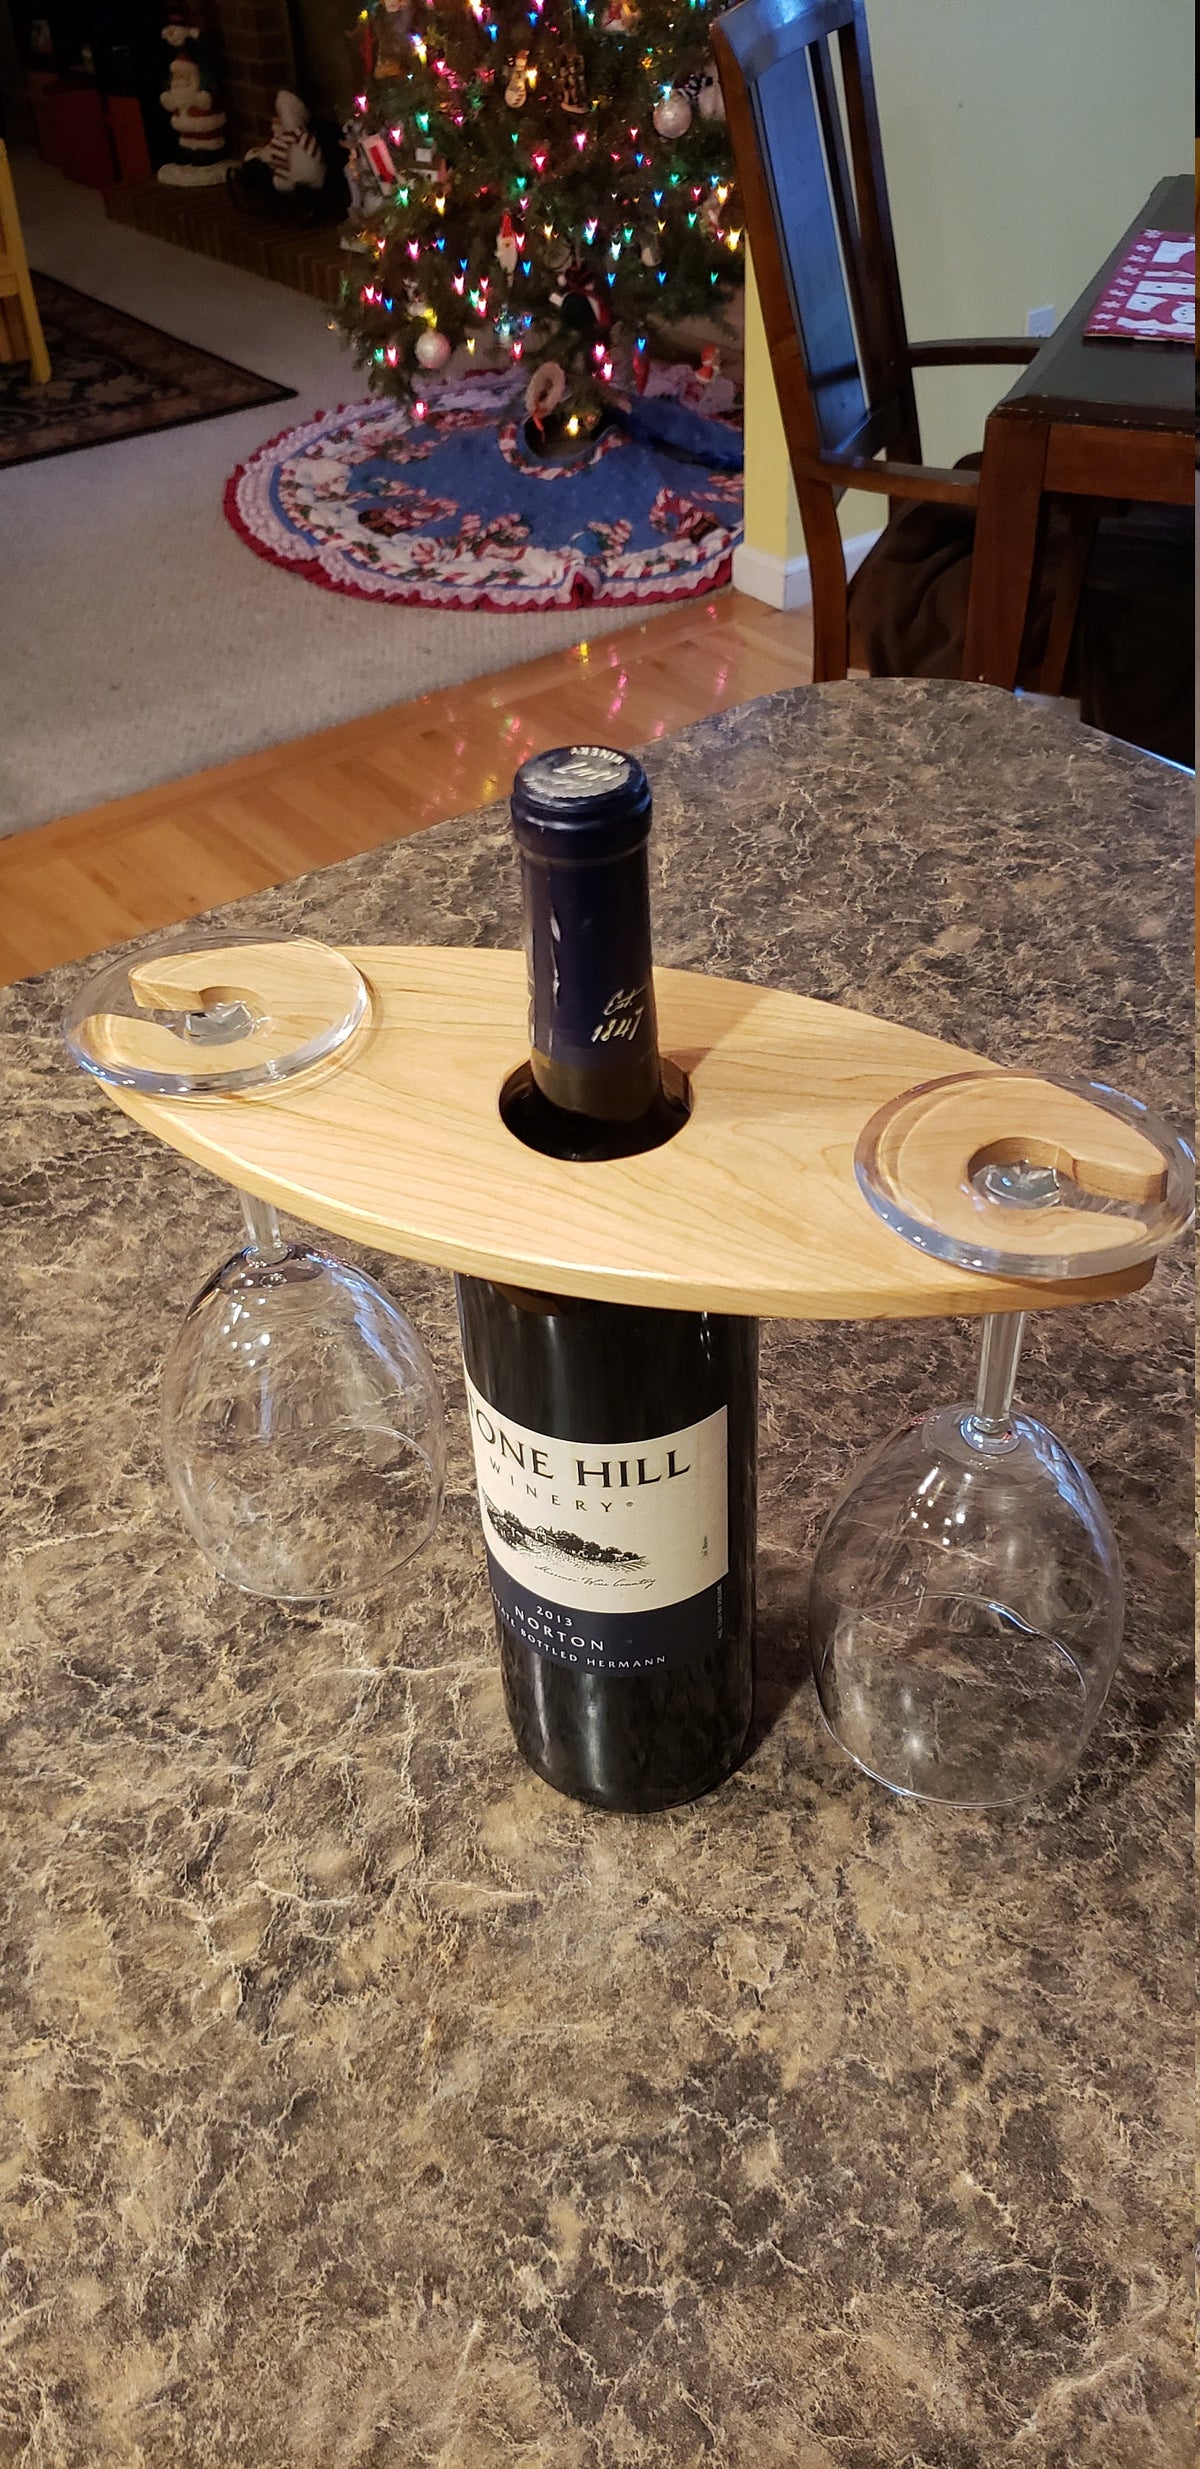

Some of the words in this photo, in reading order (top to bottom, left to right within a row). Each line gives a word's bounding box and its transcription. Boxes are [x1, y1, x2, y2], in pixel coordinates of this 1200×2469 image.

[590, 1005, 645, 1043] 1847
[466, 1389, 554, 1480] TONE
[575, 1449, 692, 1488] HILL
[489, 1455, 613, 1513] WINERY
[514, 1605, 605, 1652] NORTON
[535, 1605, 574, 1627] 2013
[520, 1628, 579, 1662] BOTTLED
[586, 1655, 666, 1669] HERMANN
